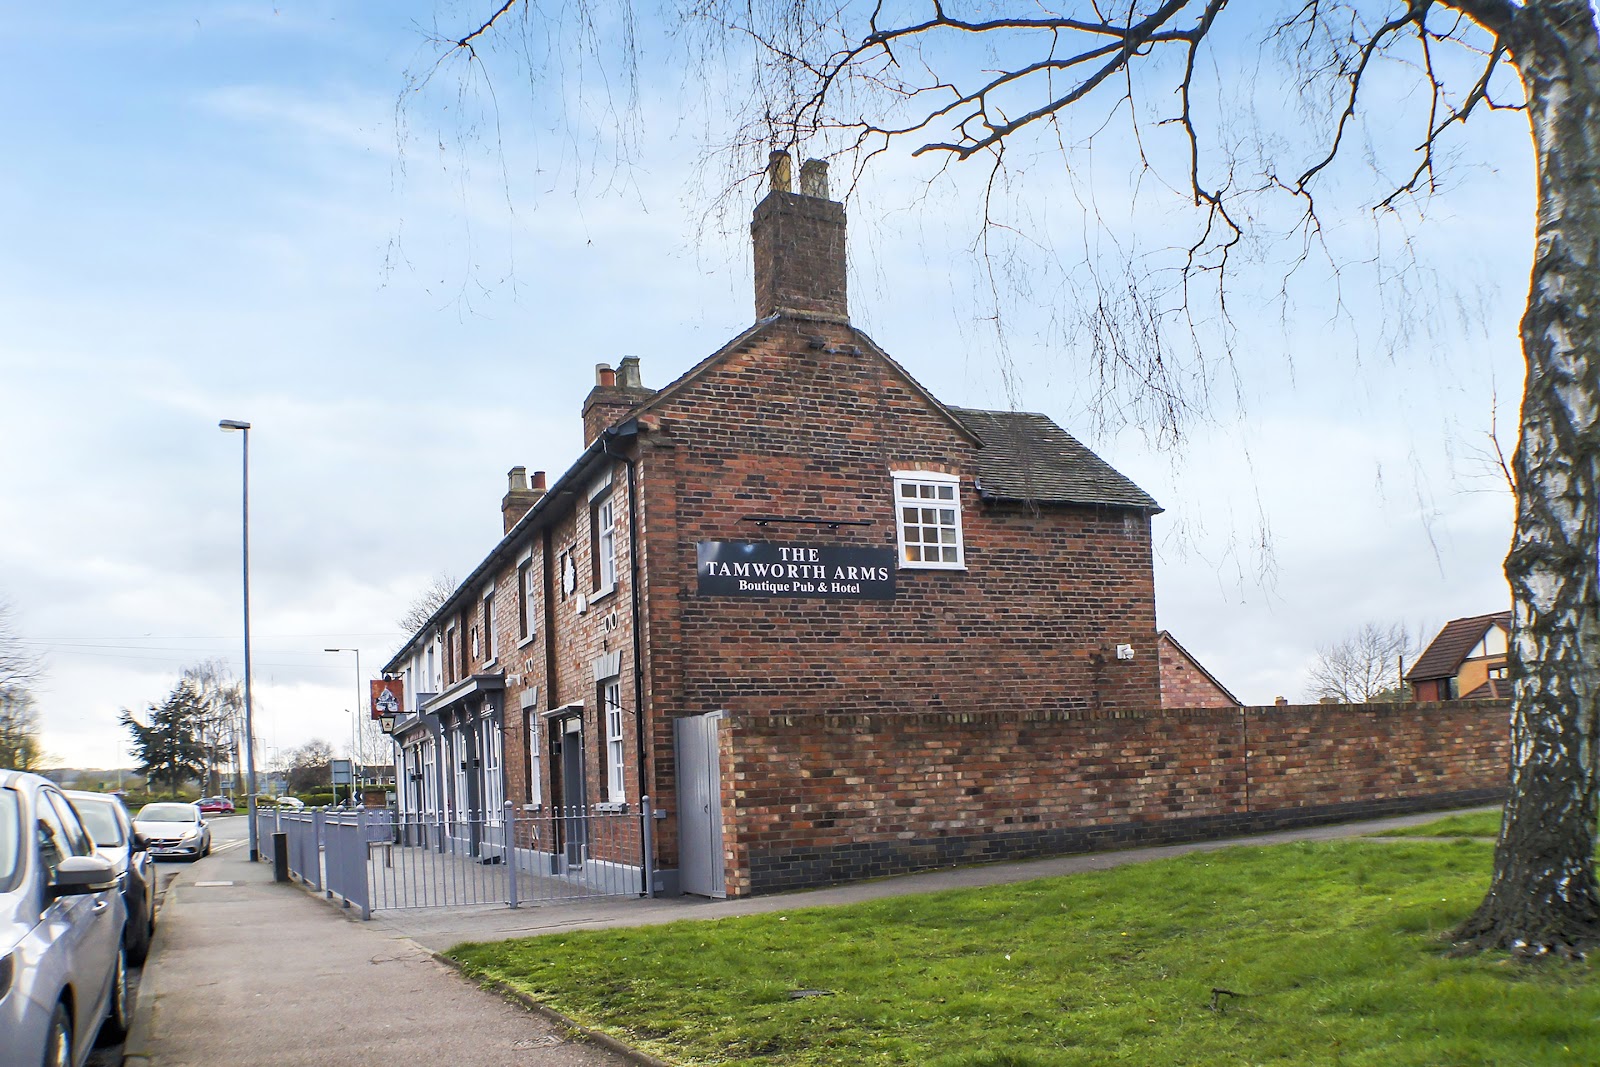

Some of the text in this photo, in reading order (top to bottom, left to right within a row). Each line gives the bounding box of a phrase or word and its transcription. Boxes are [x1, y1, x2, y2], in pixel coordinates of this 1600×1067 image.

[779, 547, 820, 562] THE
[706, 562, 889, 581] TAMWORTH ARMS
[739, 580, 860, 594] Boutique Pub & Hotel
